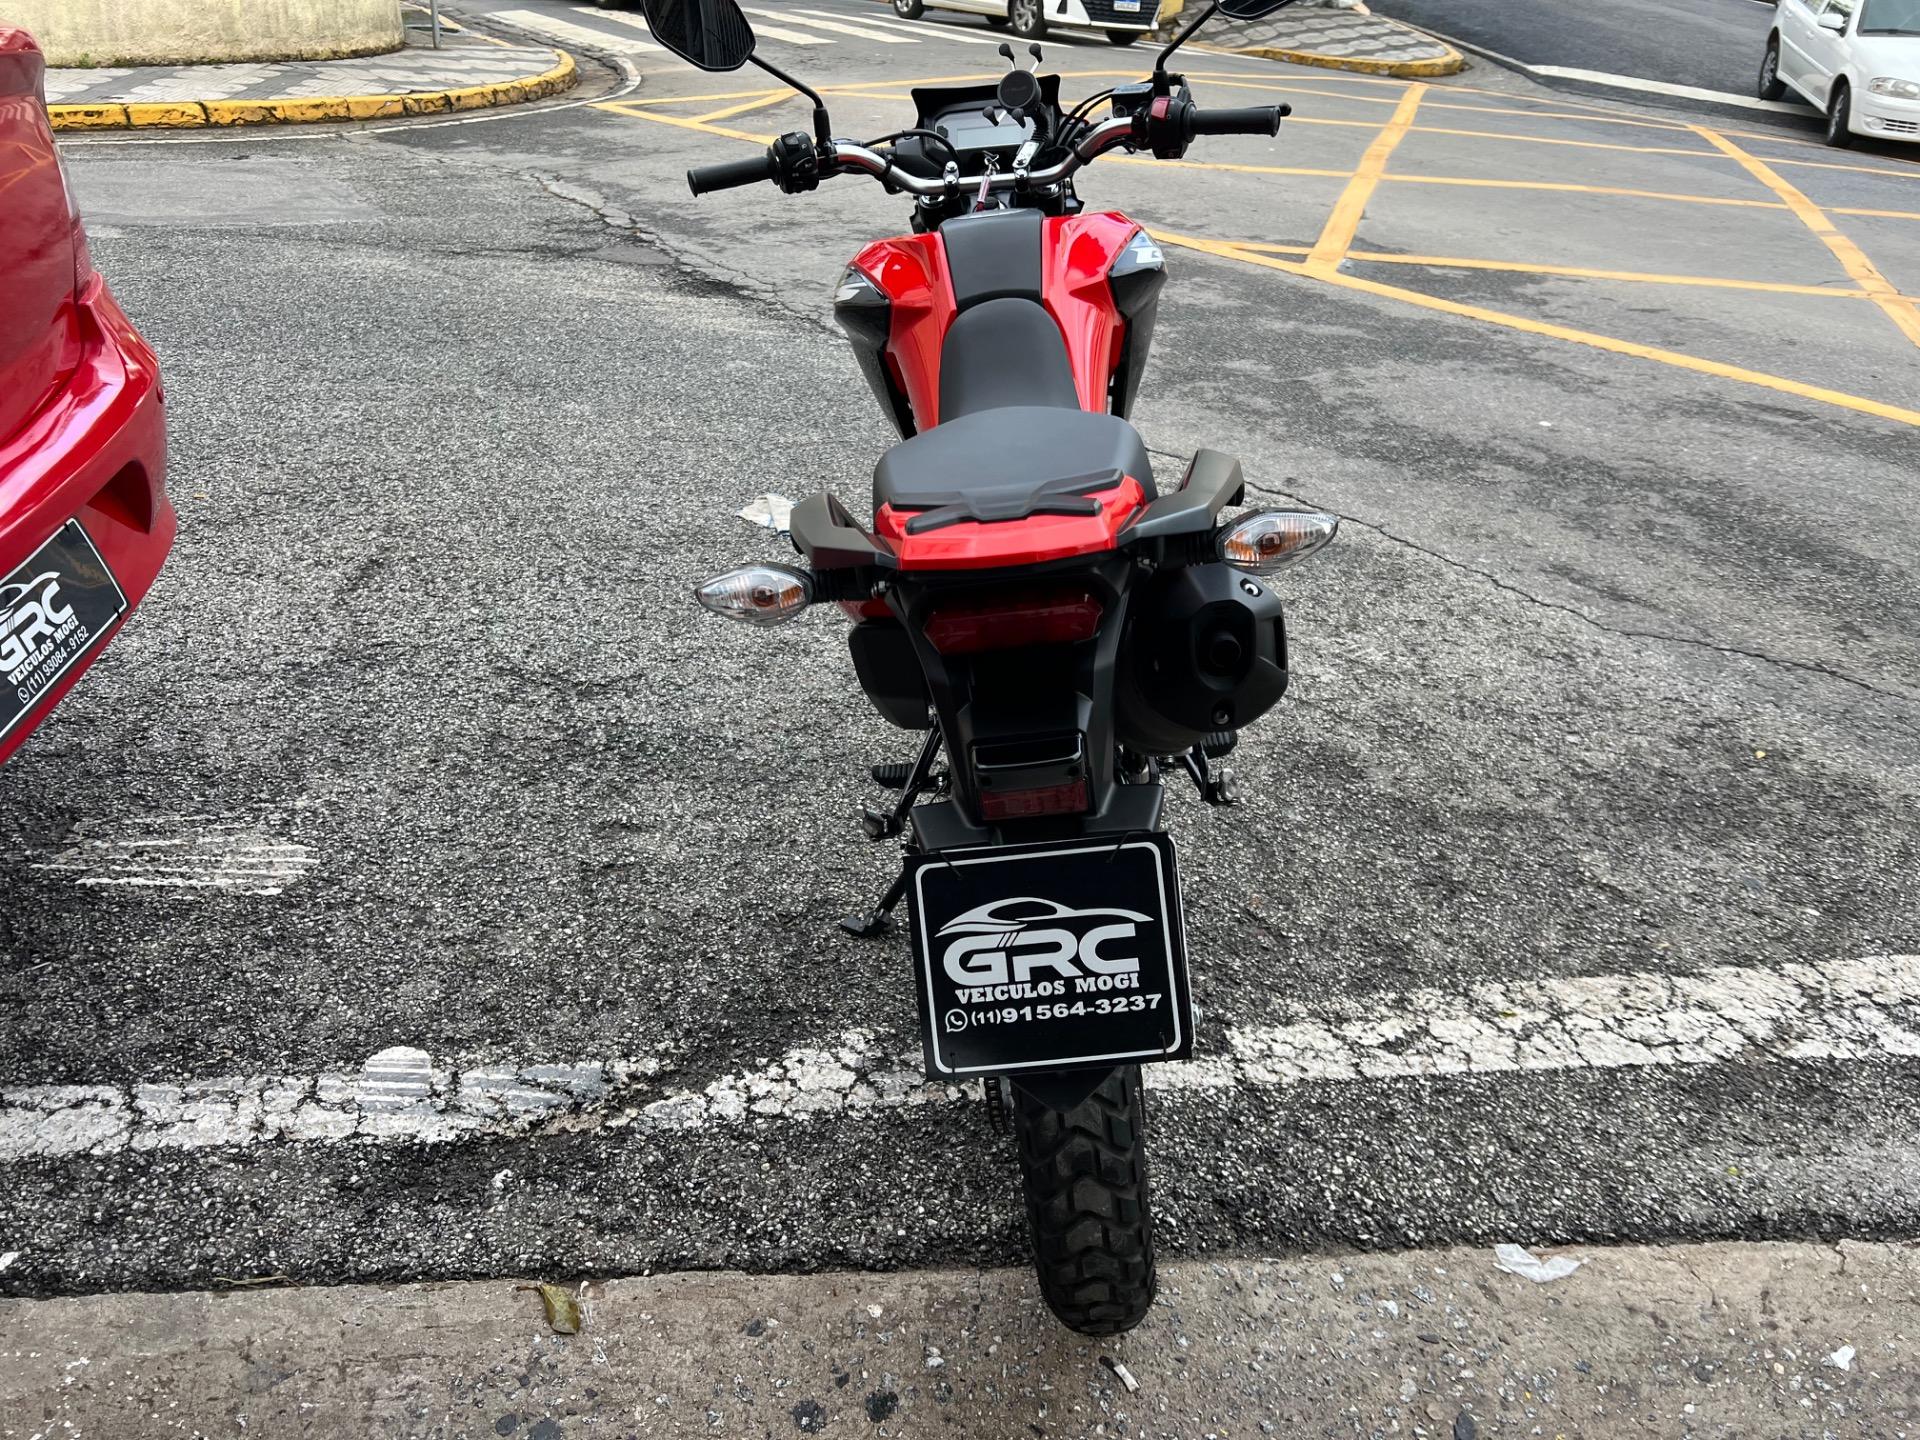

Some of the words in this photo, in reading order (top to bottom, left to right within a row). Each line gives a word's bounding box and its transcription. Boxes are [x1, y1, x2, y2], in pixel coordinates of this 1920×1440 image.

[7, 639, 54, 685] VEICULOS
[53, 614, 79, 644] MOGI
[943, 922, 1140, 986] GRC
[955, 982, 1065, 1004] VEICULOS
[1075, 973, 1140, 994] MOGI
